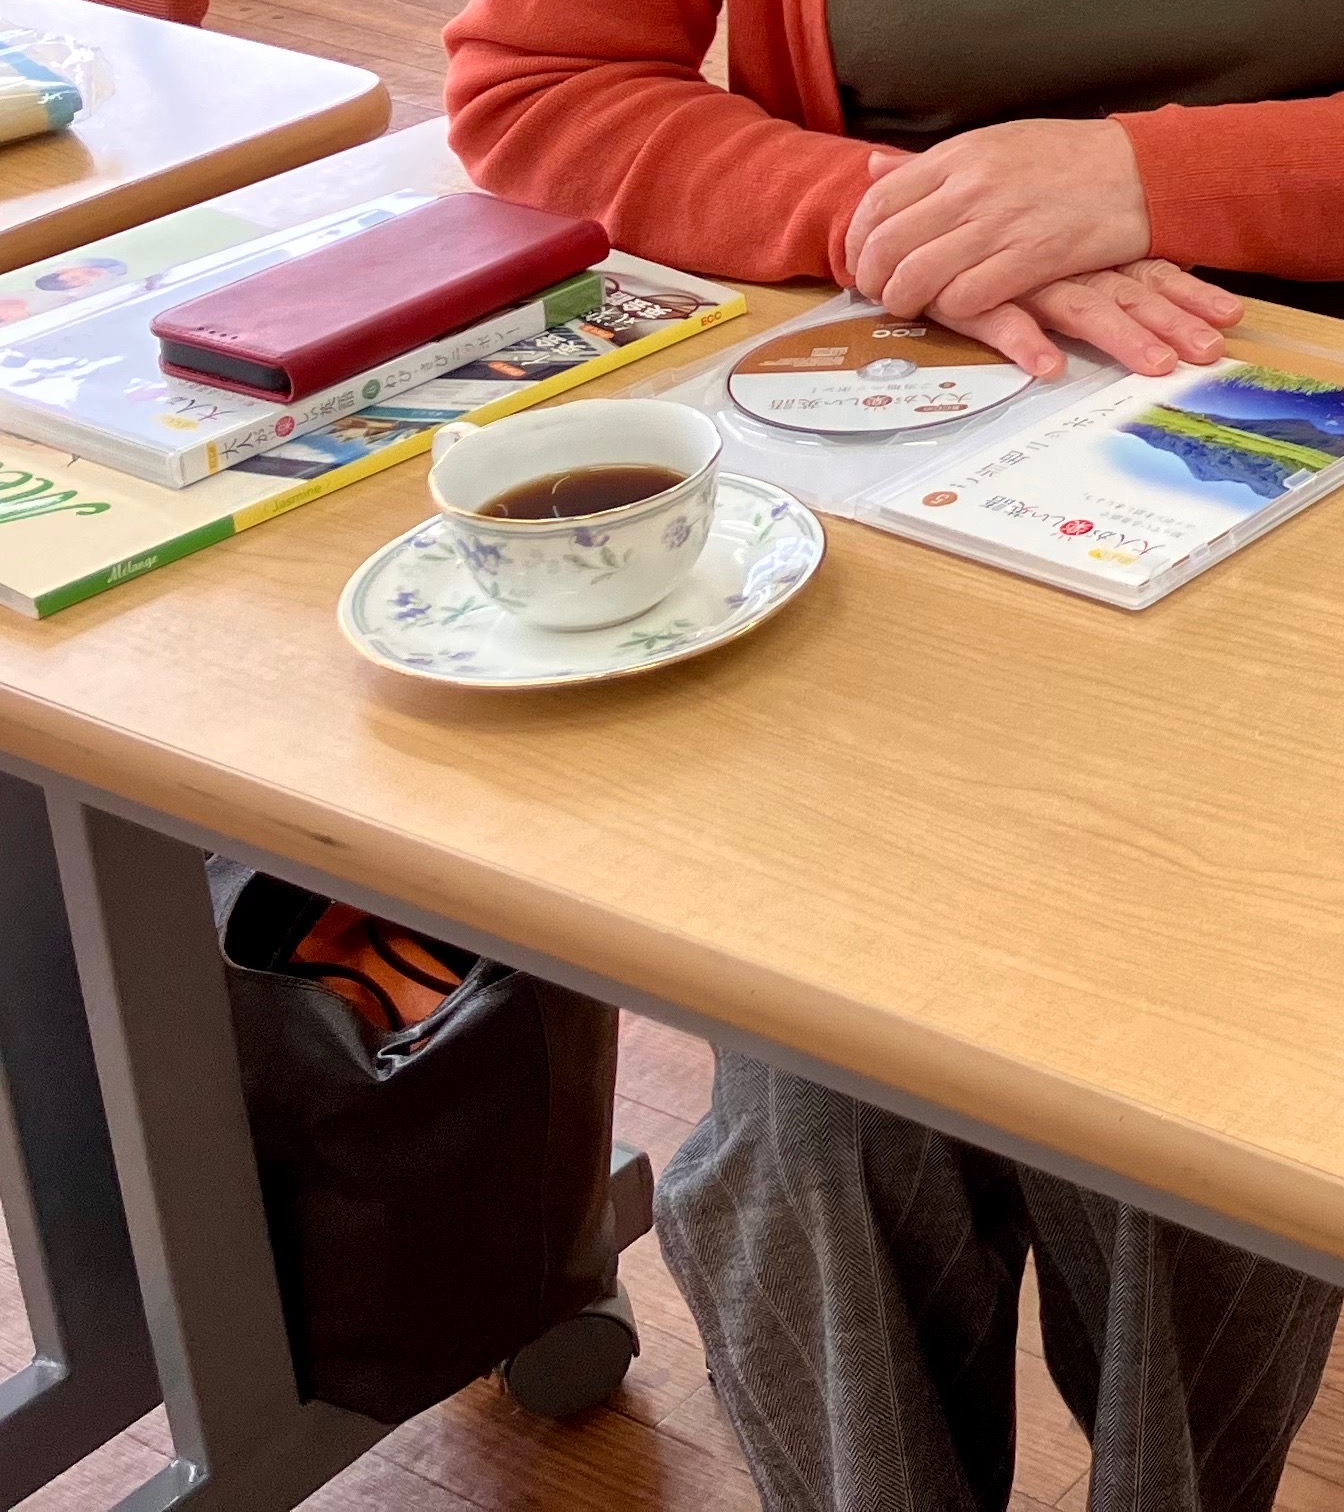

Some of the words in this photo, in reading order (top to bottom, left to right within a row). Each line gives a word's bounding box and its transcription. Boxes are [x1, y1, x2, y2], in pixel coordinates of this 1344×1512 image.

[700, 311, 722, 327] ECC
[872, 327, 928, 339] ECC
[932, 493, 950, 504] 5
[978, 495, 1166, 556] 大人が楽しい英語
